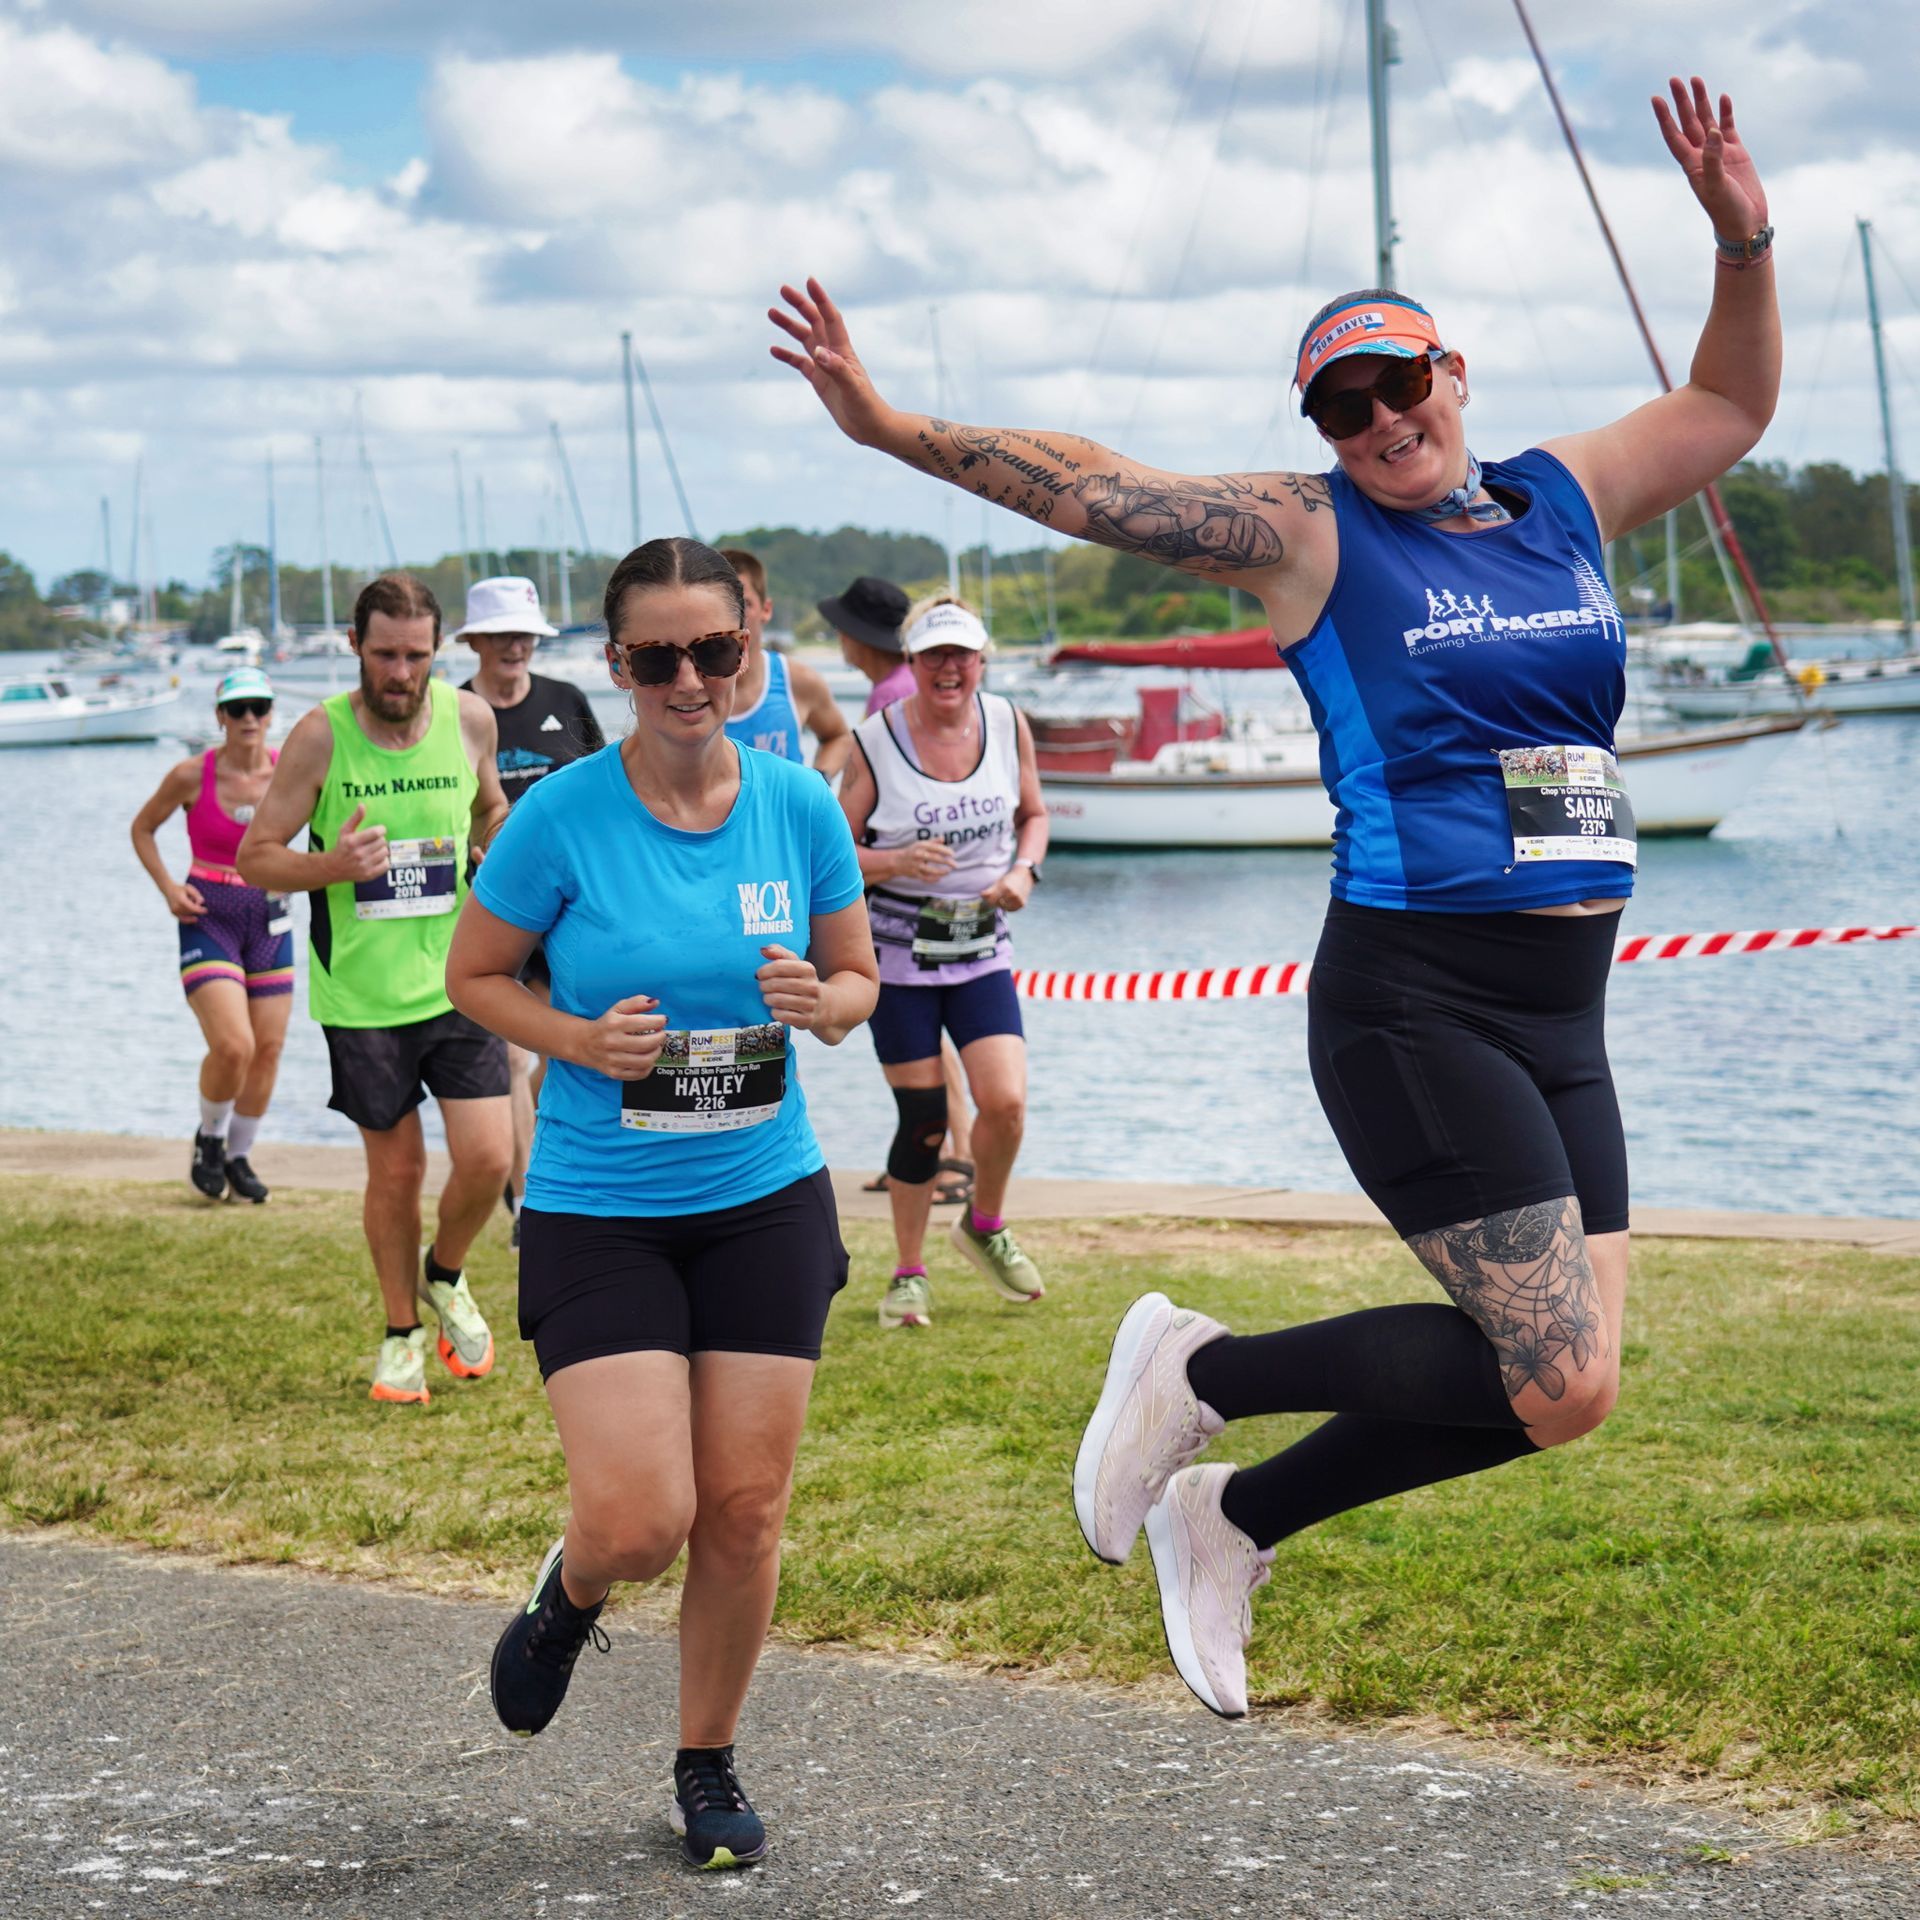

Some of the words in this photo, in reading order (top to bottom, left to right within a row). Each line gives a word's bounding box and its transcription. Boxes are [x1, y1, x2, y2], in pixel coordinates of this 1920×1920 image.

[1316, 334, 1333, 354] RUN
[1336, 314, 1373, 336] HAVEN
[1001, 430, 1031, 444] own
[1034, 438, 1065, 463] kind
[1065, 460, 1080, 472] of
[976, 436, 1075, 495] Beautiful
[1403, 617, 1484, 648] PORT
[1490, 609, 1597, 632] PACERS
[1408, 636, 1465, 657] Running
[1469, 631, 1500, 643] Club
[1504, 630, 1526, 641] Port
[1530, 626, 1599, 639] Macquarie
[342, 782, 387, 798] TEAM
[1540, 787, 1558, 797] Chop
[1566, 786, 1580, 795] Chill
[914, 795, 1006, 825] Grafton
[1564, 796, 1613, 819] SARAH
[1580, 820, 1606, 835] 2379
[387, 867, 427, 888] LEON
[743, 919, 793, 936] RUNNERS
[656, 1067, 675, 1076] Chop
[684, 1067, 700, 1075] Chill
[715, 1066, 736, 1074] Family
[675, 1074, 745, 1096] HAYLEY
[694, 1096, 726, 1111] 2216
